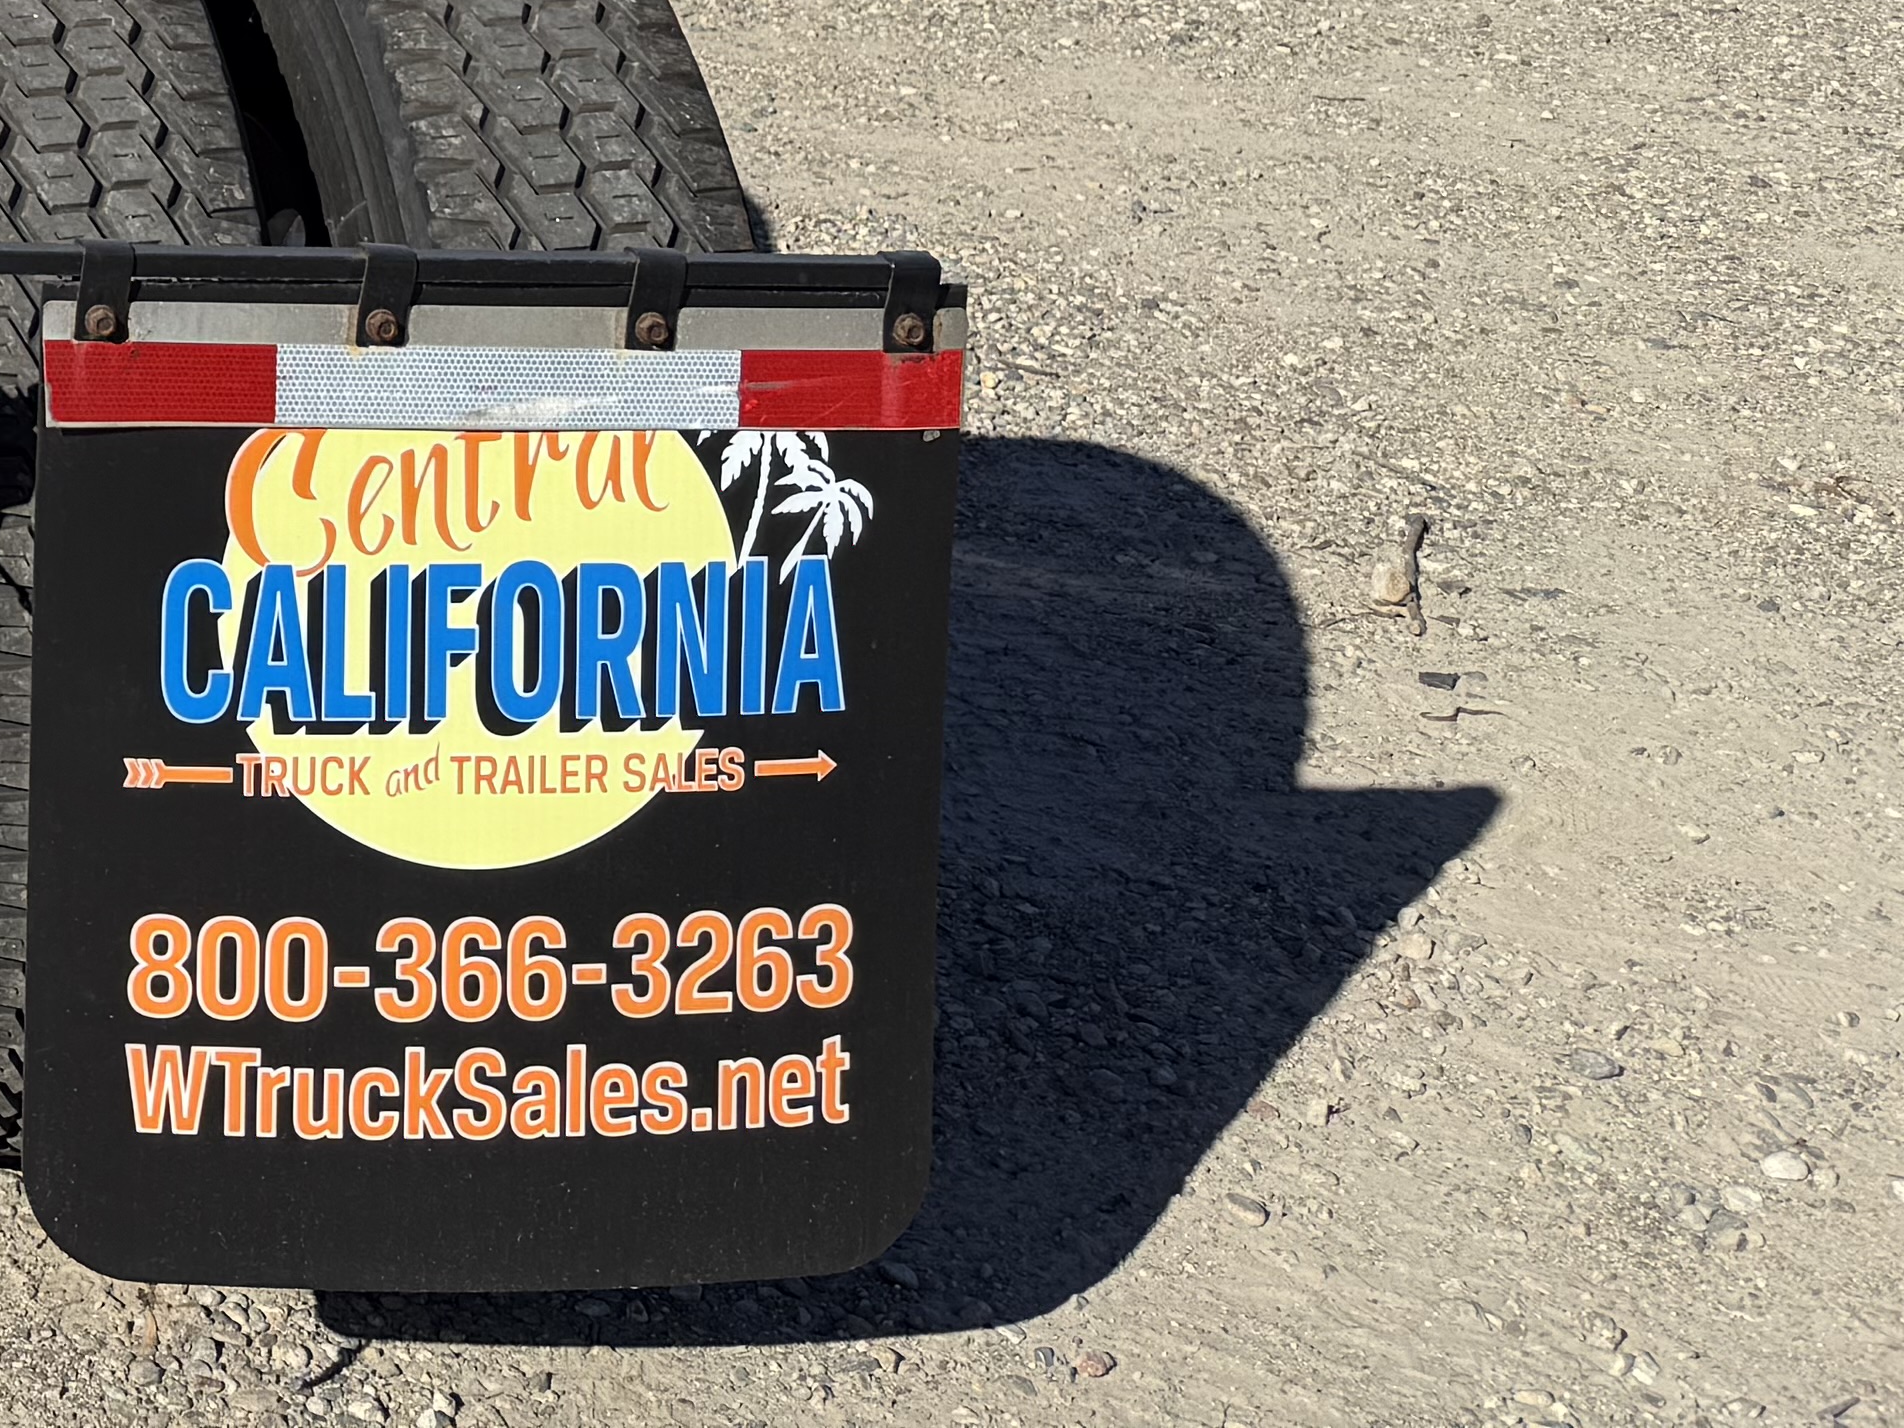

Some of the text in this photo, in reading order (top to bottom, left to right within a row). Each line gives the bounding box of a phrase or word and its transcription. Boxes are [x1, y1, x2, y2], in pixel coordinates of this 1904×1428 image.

[160, 555, 847, 725] CALIFORNIA
[235, 742, 746, 800] TRUCK and TRAILER SALES
[127, 903, 855, 1024] 800-366-3263
[125, 1033, 852, 1141] WTruckSales.net
